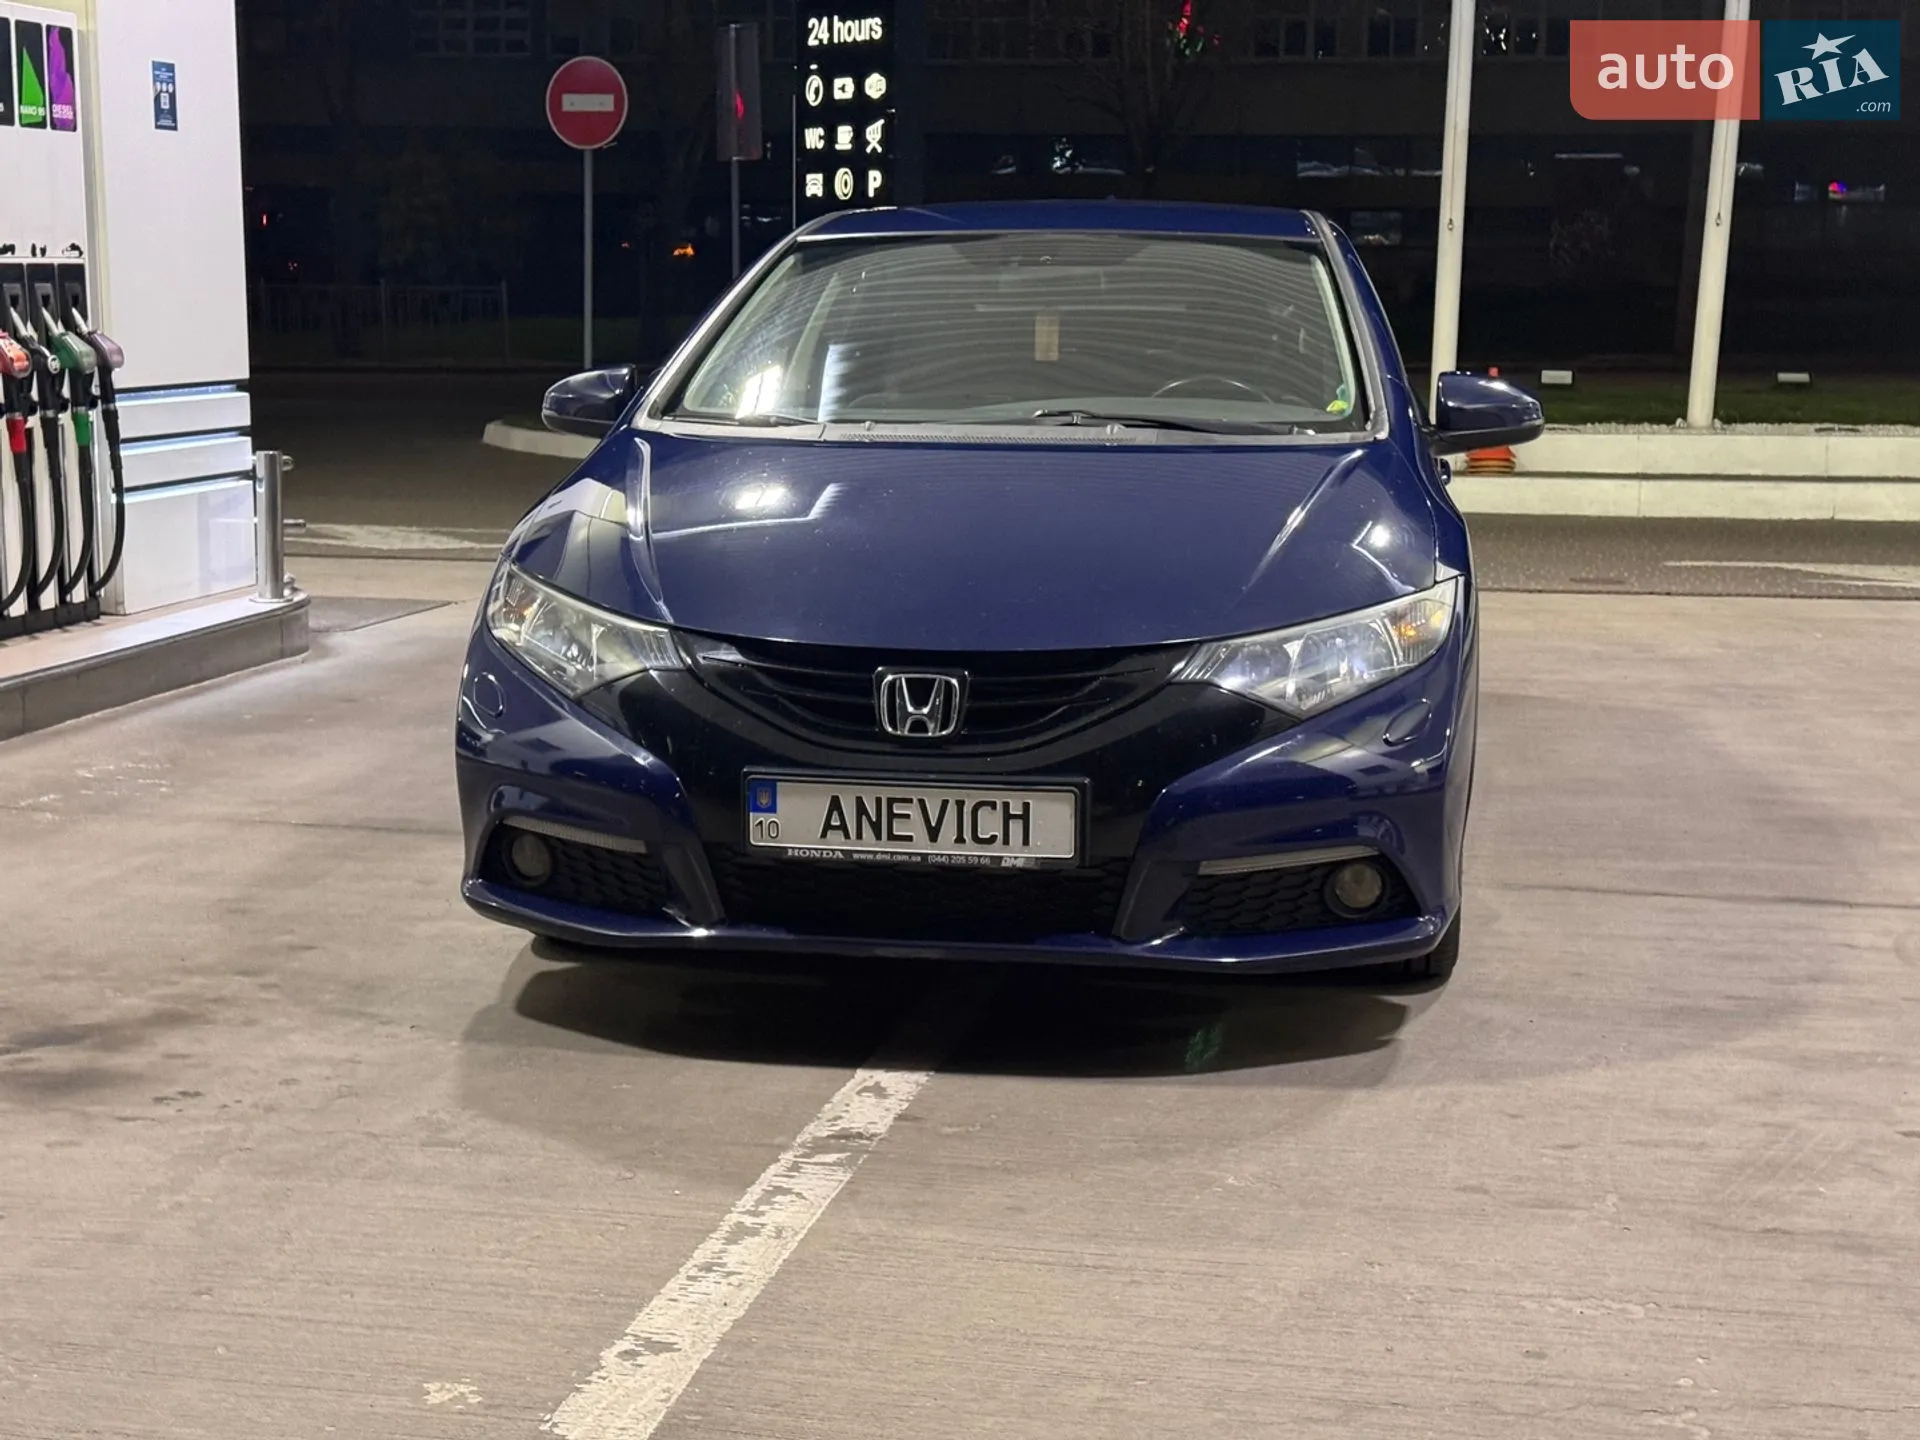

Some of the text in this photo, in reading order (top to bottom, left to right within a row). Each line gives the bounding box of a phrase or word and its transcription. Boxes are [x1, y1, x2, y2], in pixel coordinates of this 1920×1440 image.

[807, 15, 882, 46] 24 hours
[804, 127, 825, 149] WC
[868, 169, 882, 198] P
[754, 817, 779, 839] 10
[819, 795, 1031, 847] ANEVICH
[787, 847, 845, 859] HONDA
[852, 852, 921, 863] www.dmi.com.ua
